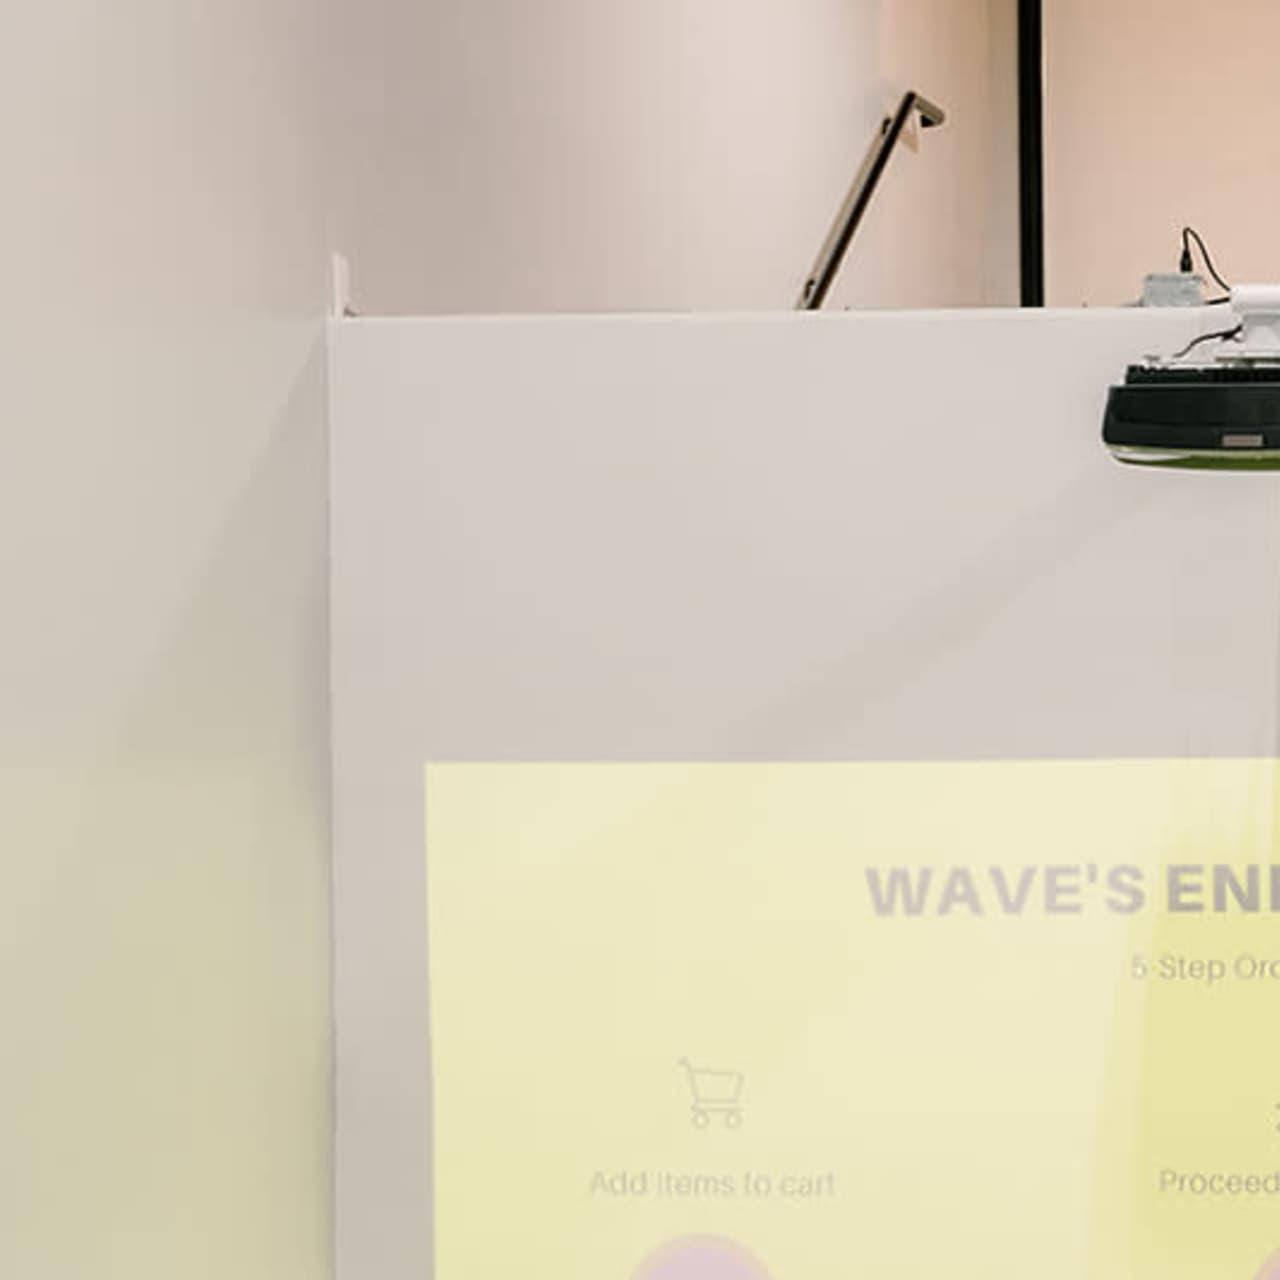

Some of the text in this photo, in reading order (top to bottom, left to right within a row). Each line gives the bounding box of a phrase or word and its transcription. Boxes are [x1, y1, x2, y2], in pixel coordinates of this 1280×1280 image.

[865, 863, 1146, 916] WAVE'S
[588, 1170, 836, 1198] Add items to cart
[1159, 1169, 1280, 1196] Proceed
